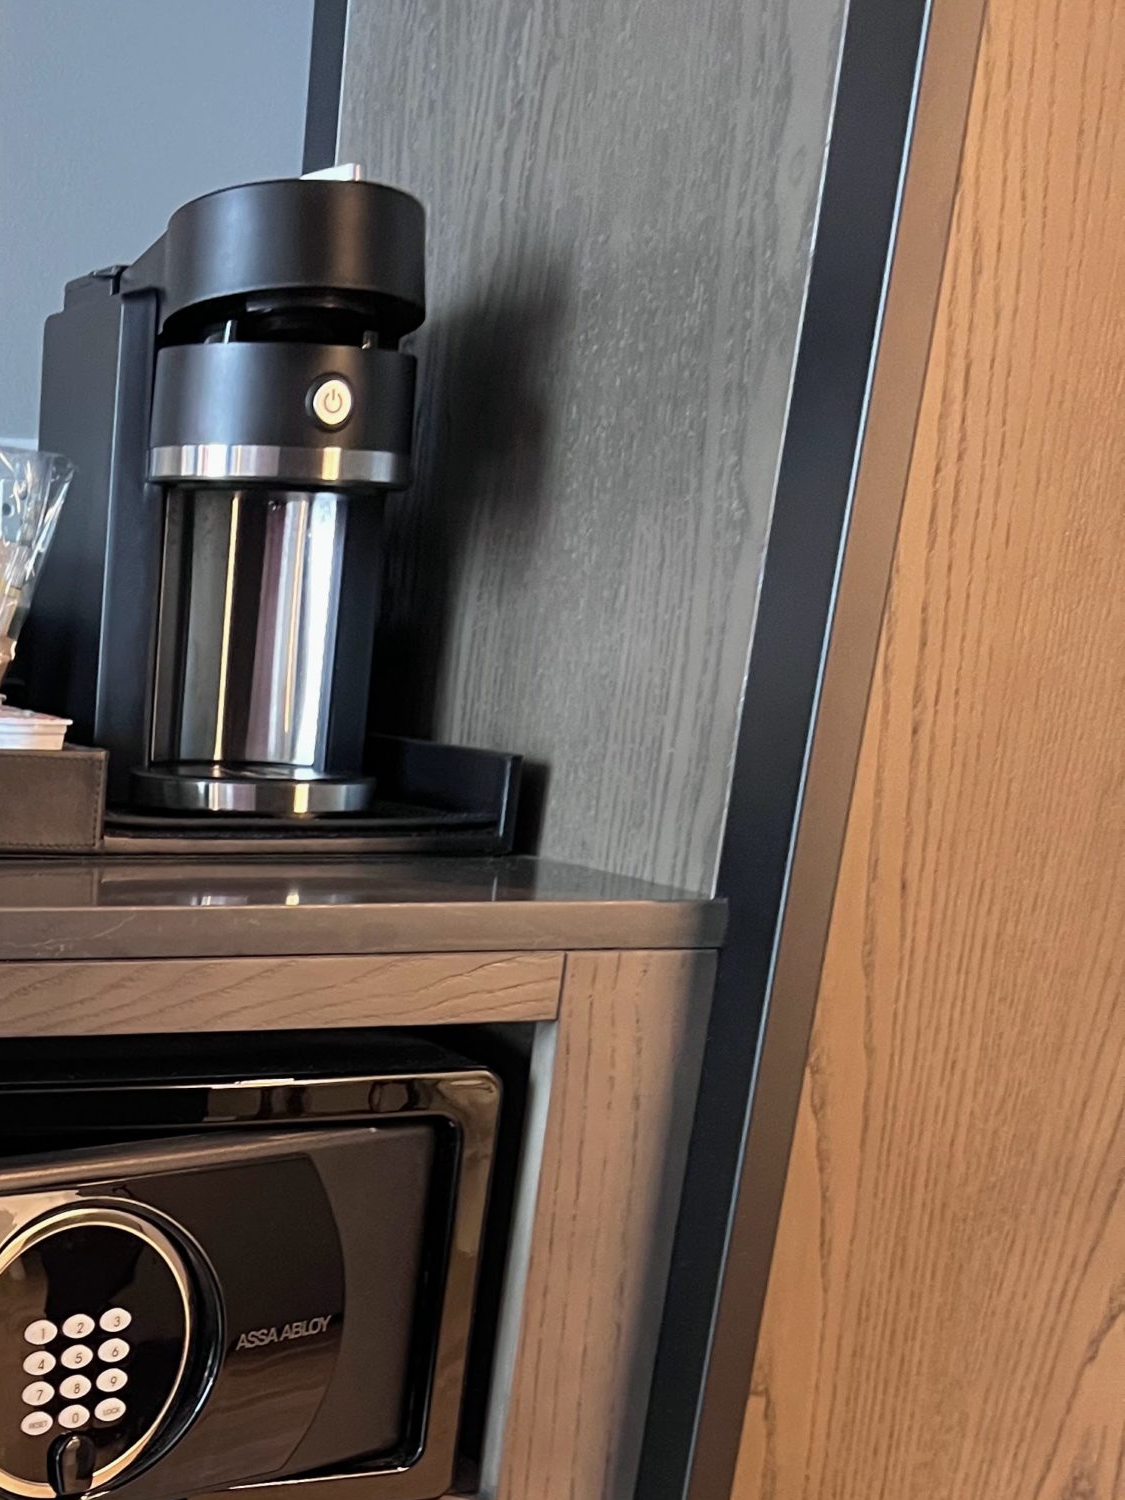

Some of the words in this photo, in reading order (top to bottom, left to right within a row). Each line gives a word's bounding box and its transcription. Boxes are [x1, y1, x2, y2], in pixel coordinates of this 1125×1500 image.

[76, 1322, 84, 1334] 2
[113, 1315, 121, 1327] 3
[235, 1327, 278, 1350] ASSA
[279, 1315, 332, 1341] ABLOY
[37, 1358, 45, 1370] 4
[74, 1352, 83, 1364] 5
[111, 1346, 119, 1358] 6
[36, 1389, 44, 1401] 7
[73, 1383, 80, 1395] 8
[110, 1376, 117, 1387] 9
[71, 1412, 79, 1424] 0
